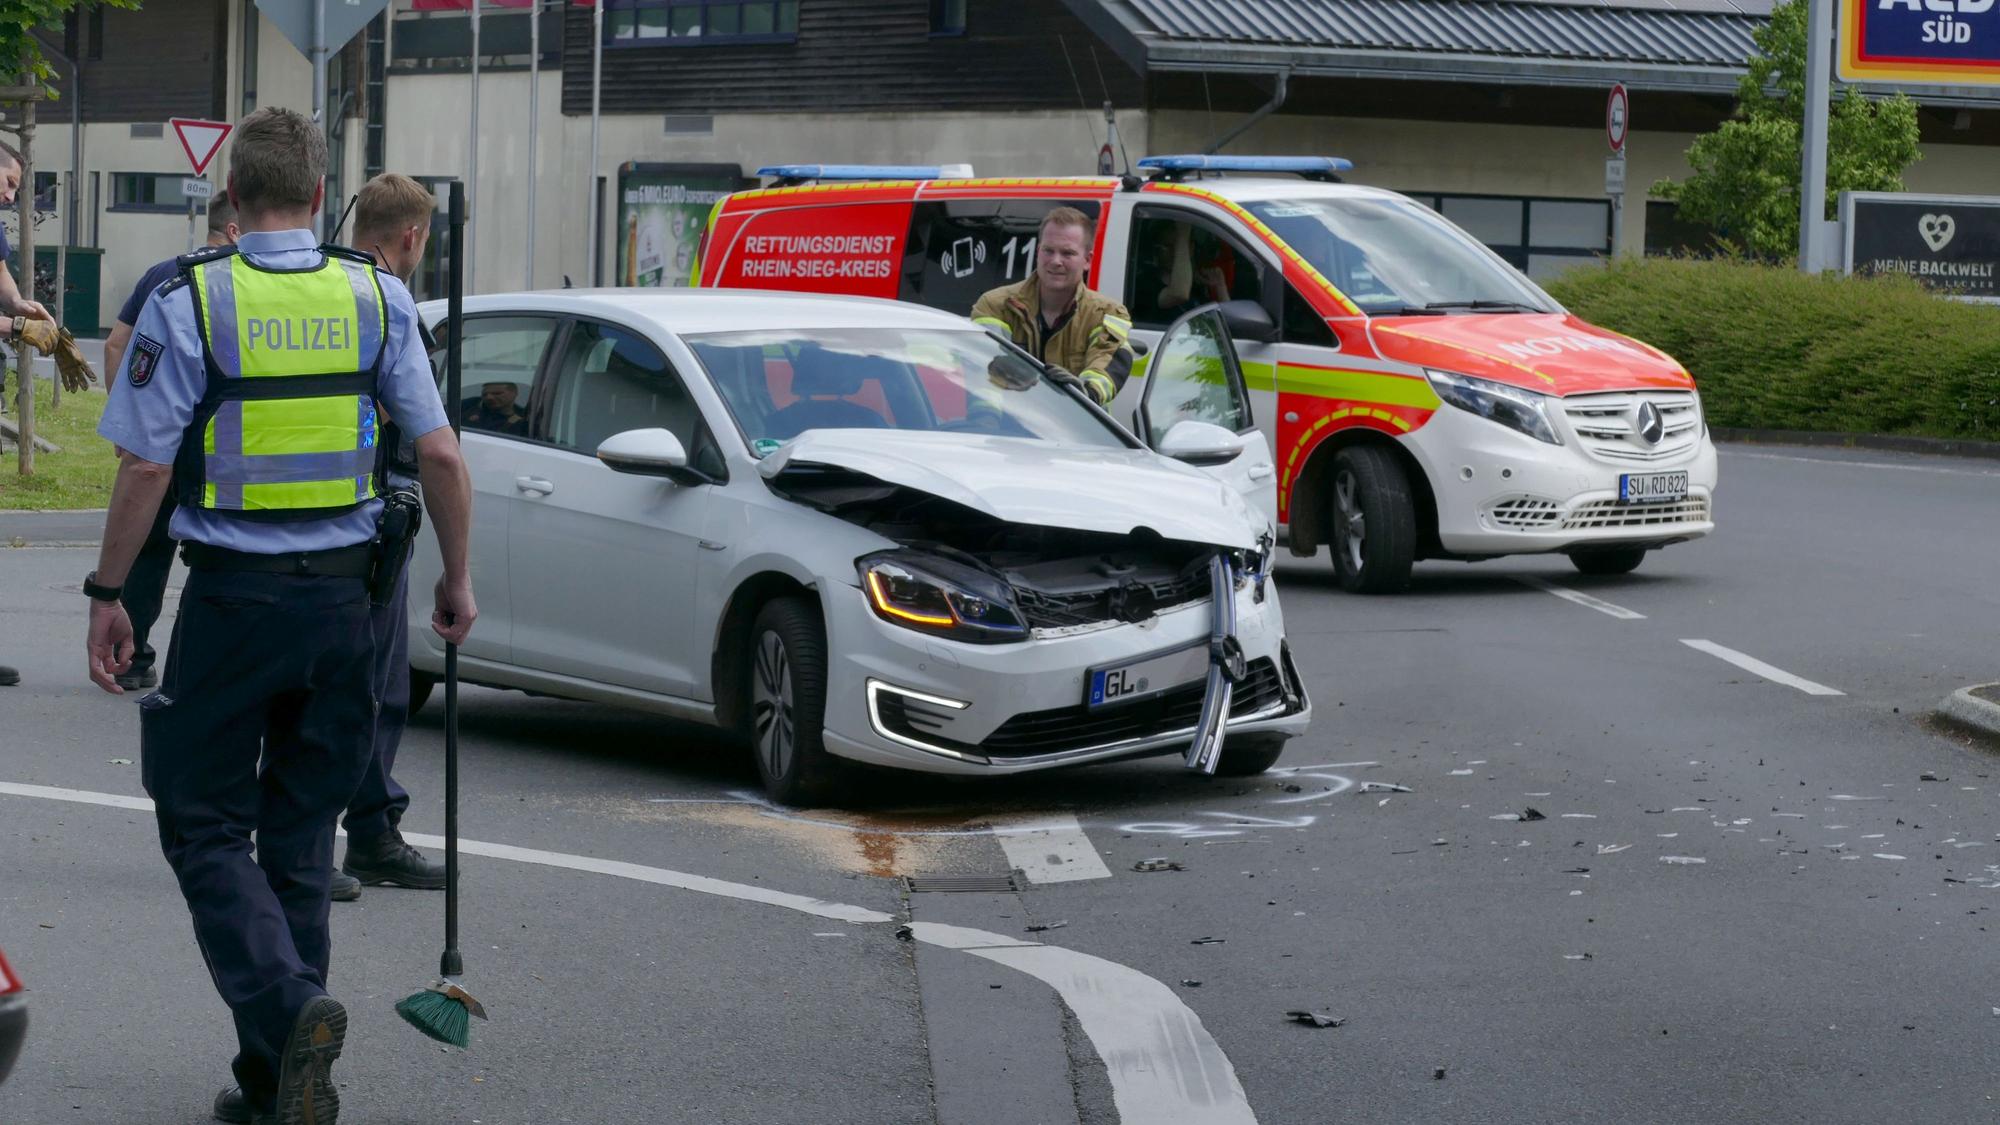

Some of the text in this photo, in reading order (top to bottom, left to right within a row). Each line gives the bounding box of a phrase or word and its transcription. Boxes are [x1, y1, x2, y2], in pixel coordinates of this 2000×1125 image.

[1921, 14, 1971, 43] SÜD
[745, 235, 895, 254] RETTUNGSDIENST
[742, 259, 891, 277] RHEIN-SIEG-KREIS
[1001, 236, 1037, 279] 11
[1874, 258, 1994, 277] MEINE BACKWELT
[136, 335, 161, 354] POLIZEI
[247, 317, 350, 351] POLIZEI
[1629, 477, 1644, 496] SU
[1652, 476, 1666, 495] RD
[1668, 475, 1686, 493] 822
[1105, 670, 1135, 698] GL
